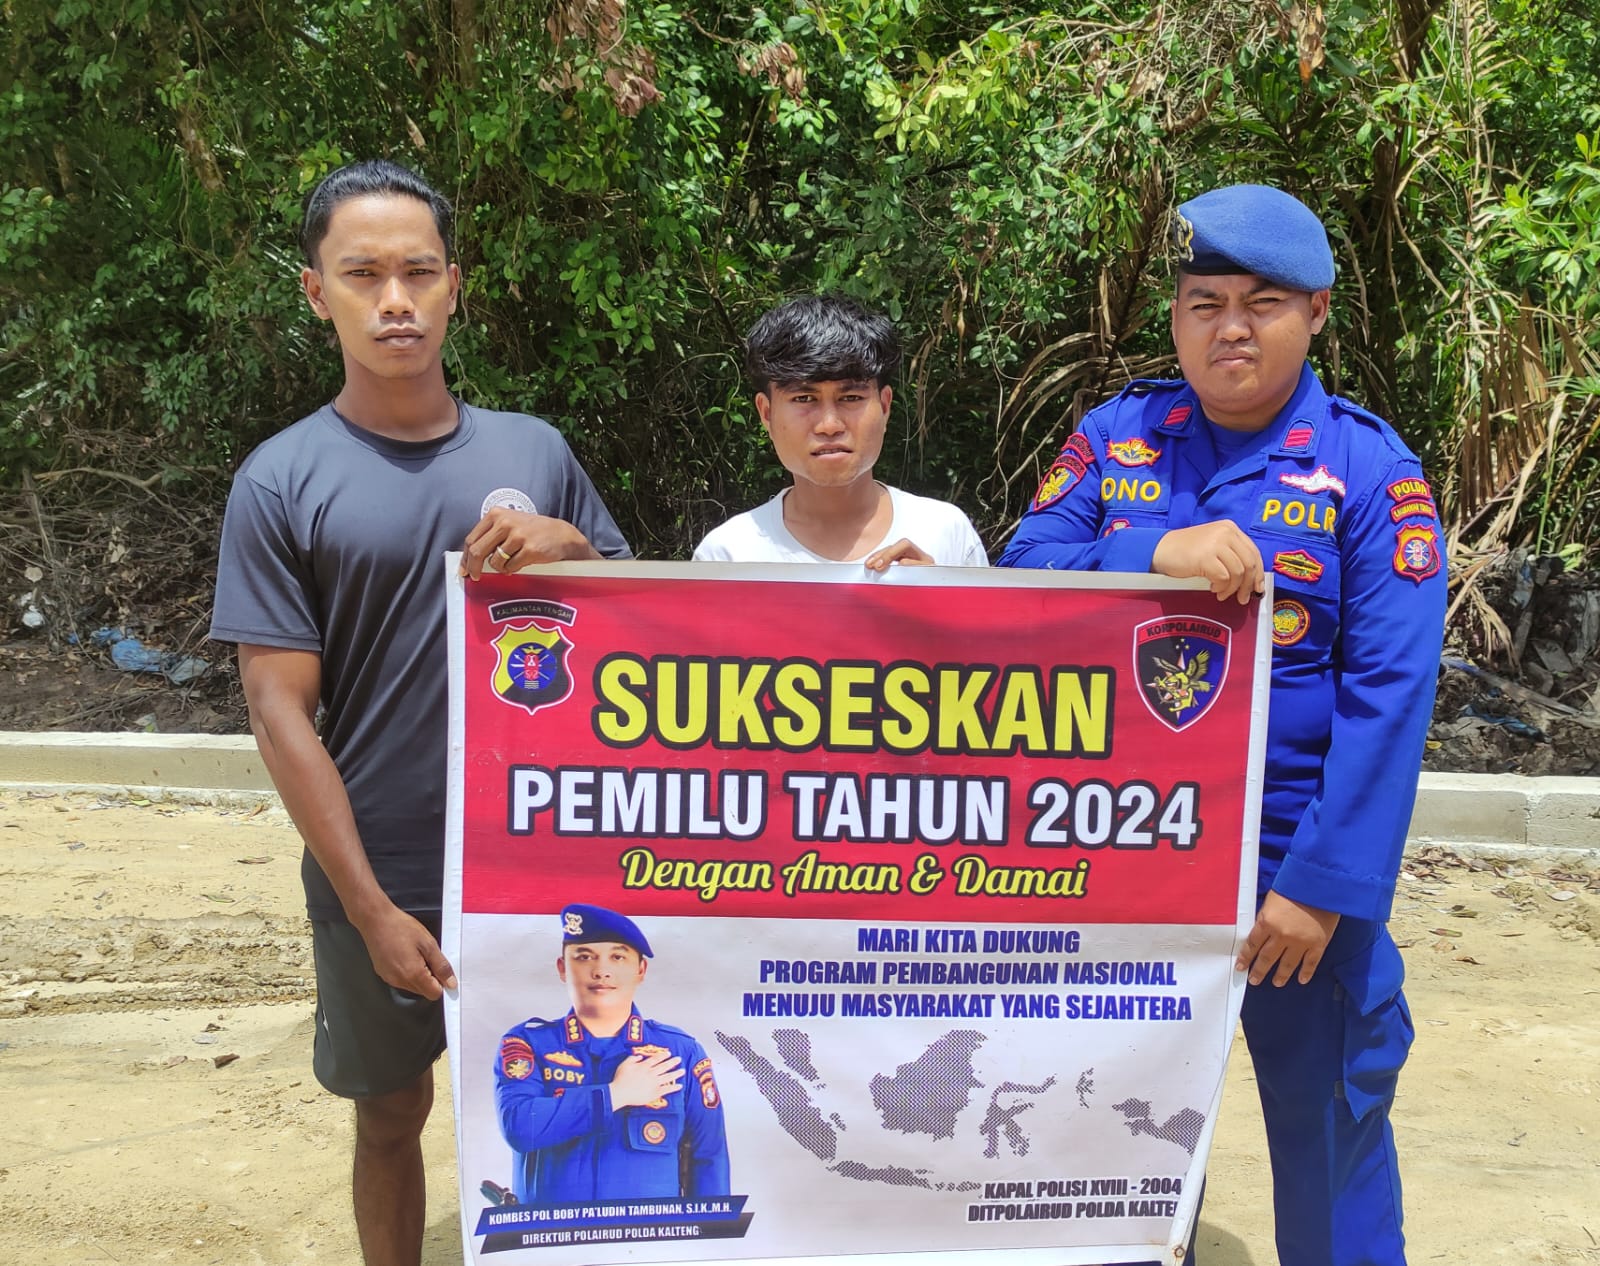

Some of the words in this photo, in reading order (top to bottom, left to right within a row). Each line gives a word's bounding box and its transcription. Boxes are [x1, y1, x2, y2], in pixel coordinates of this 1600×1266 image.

[1393, 481, 1427, 497] POLDA
[1146, 622, 1222, 638] KORPOLAIRUD
[597, 657, 1110, 753] SUKSESKAN
[511, 768, 764, 837] PEMILU
[787, 775, 1006, 842] TAHUN
[1029, 781, 1199, 846] 2024
[621, 848, 773, 900] Dengan
[782, 852, 900, 895] Aman
[909, 855, 943, 894] &
[954, 856, 1088, 896] Damai
[858, 928, 918, 952] MARI
[925, 929, 977, 953] KITA
[983, 930, 1080, 954] DUKUNG
[760, 960, 876, 984] PROGRAM
[882, 962, 1058, 985] PEMBANGUNAN
[1063, 961, 1177, 986] NASIONAL
[743, 993, 835, 1017] MENUJU
[841, 993, 995, 1018] MASYARAKAT
[1001, 994, 1060, 1019] YANG
[1066, 995, 1192, 1021] SEJAHTERA
[544, 1067, 585, 1085] BOBY
[984, 1181, 1033, 1199] KAPAL
[1037, 1180, 1087, 1197] POLISI
[1090, 1179, 1128, 1195] XVIII
[1140, 1178, 1182, 1195] 2004
[489, 1211, 531, 1225] KOMBES
[532, 1209, 551, 1221] POL
[553, 1208, 580, 1220] BOBY
[968, 1203, 1072, 1221] DITPOLAIRUD
[1076, 1201, 1125, 1217] POLDA
[522, 1231, 571, 1245] DIREKTUR
[574, 1228, 622, 1241] POLAIRUD
[625, 1227, 656, 1239] POLDA
[658, 1225, 699, 1237] KALTENG
